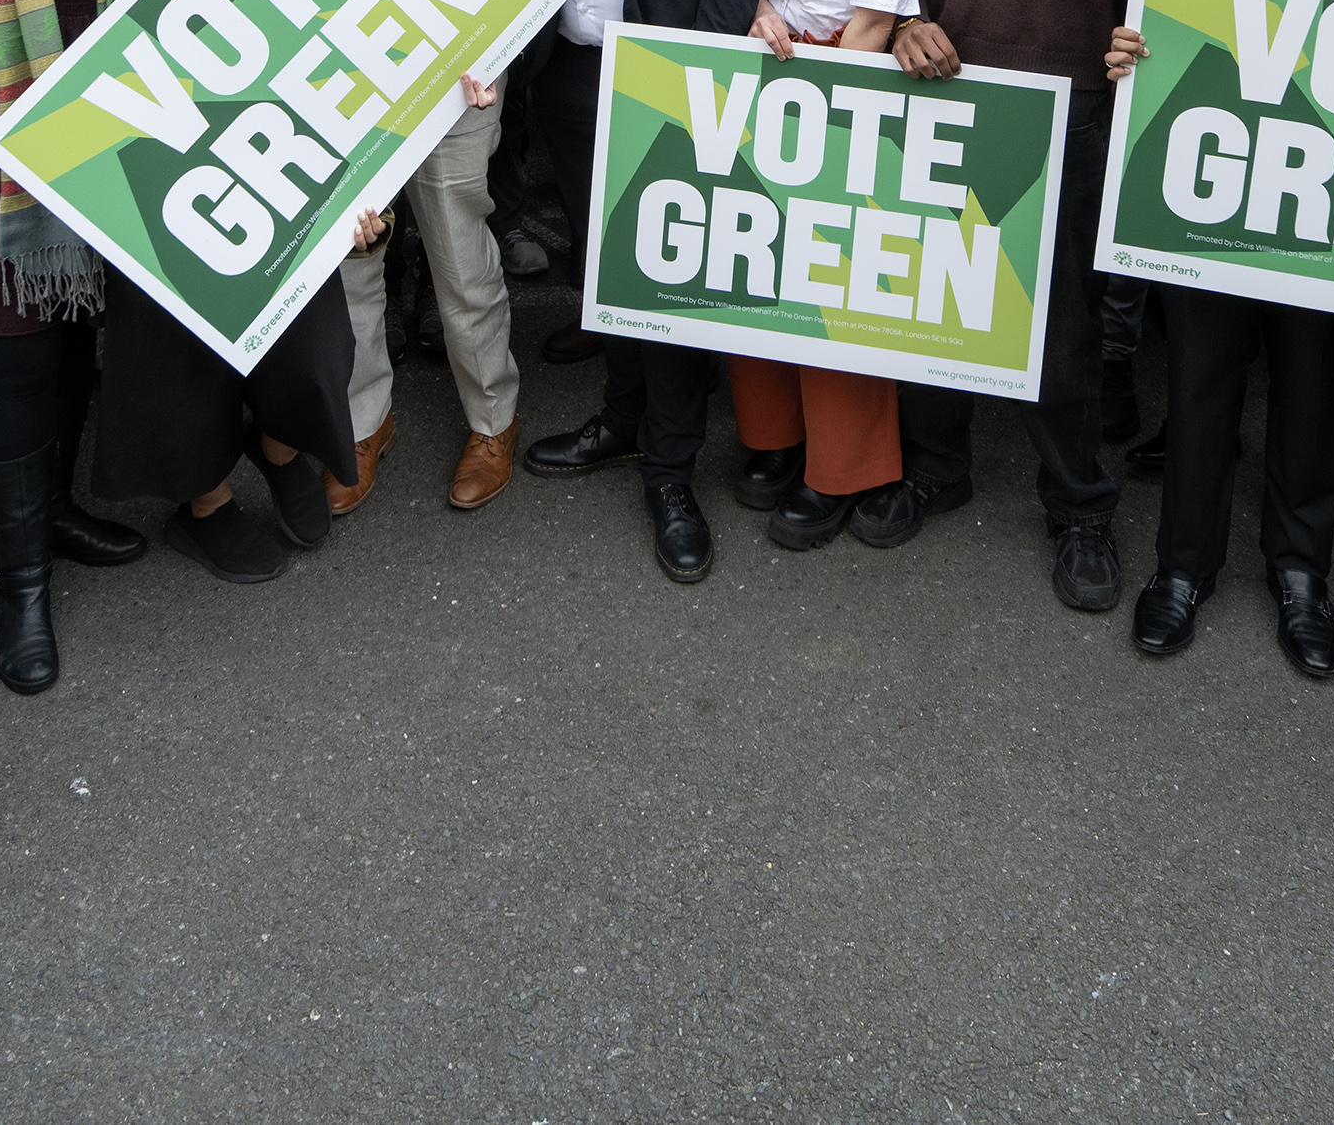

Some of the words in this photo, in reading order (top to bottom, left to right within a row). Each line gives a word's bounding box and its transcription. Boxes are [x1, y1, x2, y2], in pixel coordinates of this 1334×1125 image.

[484, 0, 553, 73] www.greenparty.org.uk
[263, 245, 293, 277] Promoted
[287, 236, 299, 248] by
[293, 220, 312, 240] Chris
[307, 197, 332, 224] Williams
[329, 190, 339, 200] on
[334, 170, 355, 192] behalf
[350, 164, 360, 174] of
[355, 152, 369, 166] The
[365, 135, 384, 156] Green
[393, 107, 409, 123] both
[405, 101, 415, 110] at
[410, 92, 422, 104] PO
[418, 82, 431, 96] Box
[443, 44, 464, 67] London
[460, 31, 475, 48] SE16
[472, 20, 487, 36] 9GQ
[684, 67, 976, 209] VOTE
[635, 179, 1001, 331] GREEN
[1135, 258, 1169, 272] Green
[1170, 264, 1201, 280] Party
[1186, 232, 1223, 245] Promoted
[1223, 238, 1233, 248] by
[1234, 240, 1255, 250] Chris
[1255, 243, 1286, 256] Williams
[1298, 251, 1323, 262] behalf
[1324, 255, 1332, 264] of
[258, 304, 287, 335] Green
[282, 279, 310, 309] Party
[616, 317, 644, 329] Green
[646, 321, 671, 335] Party
[657, 292, 688, 303] Promoted
[689, 297, 697, 306] by
[697, 298, 715, 307] Chris
[715, 301, 741, 311] Williams
[751, 306, 772, 316] behalf
[772, 309, 779, 317] of
[780, 311, 793, 319] The
[794, 313, 813, 322] Green
[833, 319, 849, 328] both
[858, 322, 868, 331] PO
[868, 324, 881, 333] Box
[905, 330, 930, 341] London
[931, 334, 947, 343] SE16
[948, 336, 964, 346] 9GQ
[927, 367, 1025, 392] www.greenparty.org.uk
